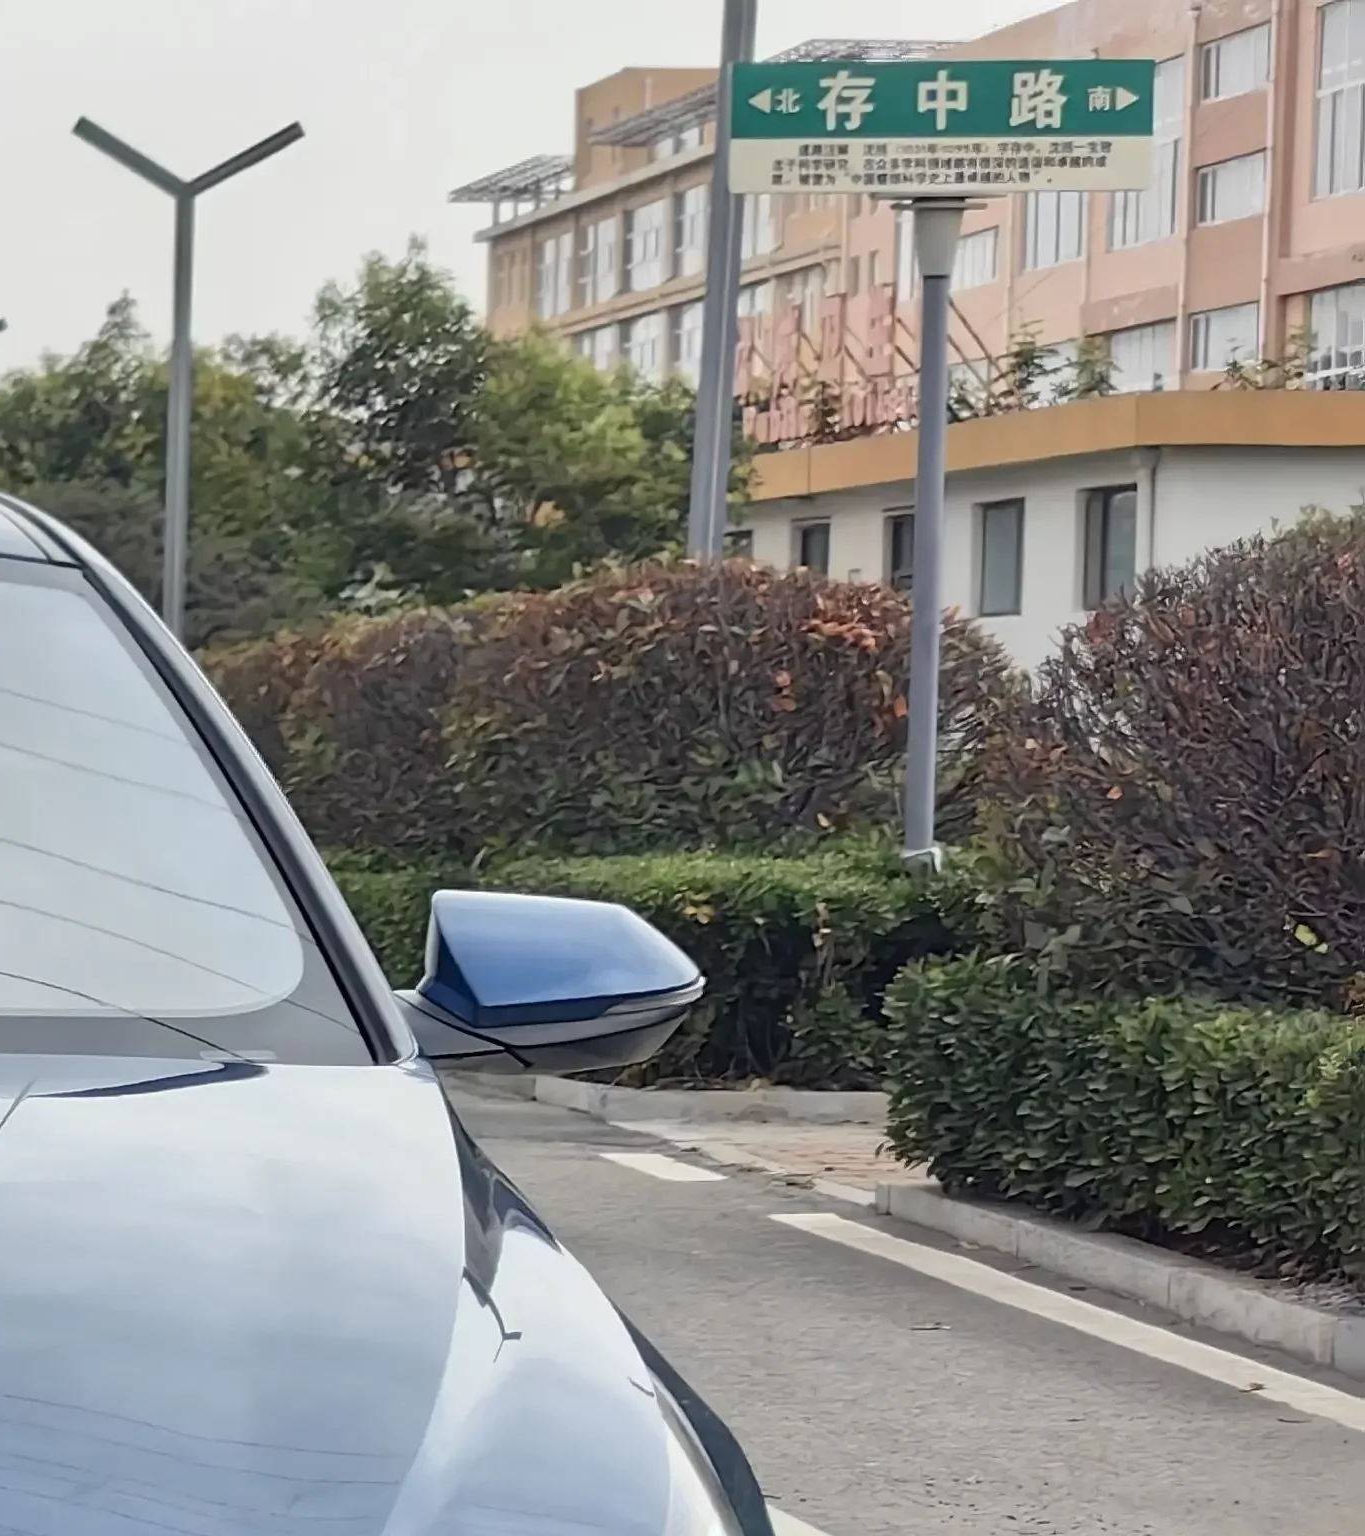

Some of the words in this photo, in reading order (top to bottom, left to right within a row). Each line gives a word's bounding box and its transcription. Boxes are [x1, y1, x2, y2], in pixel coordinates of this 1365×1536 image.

[774, 88, 800, 113] 北
[817, 70, 1068, 131] 存中路
[1088, 86, 1113, 112] 南
